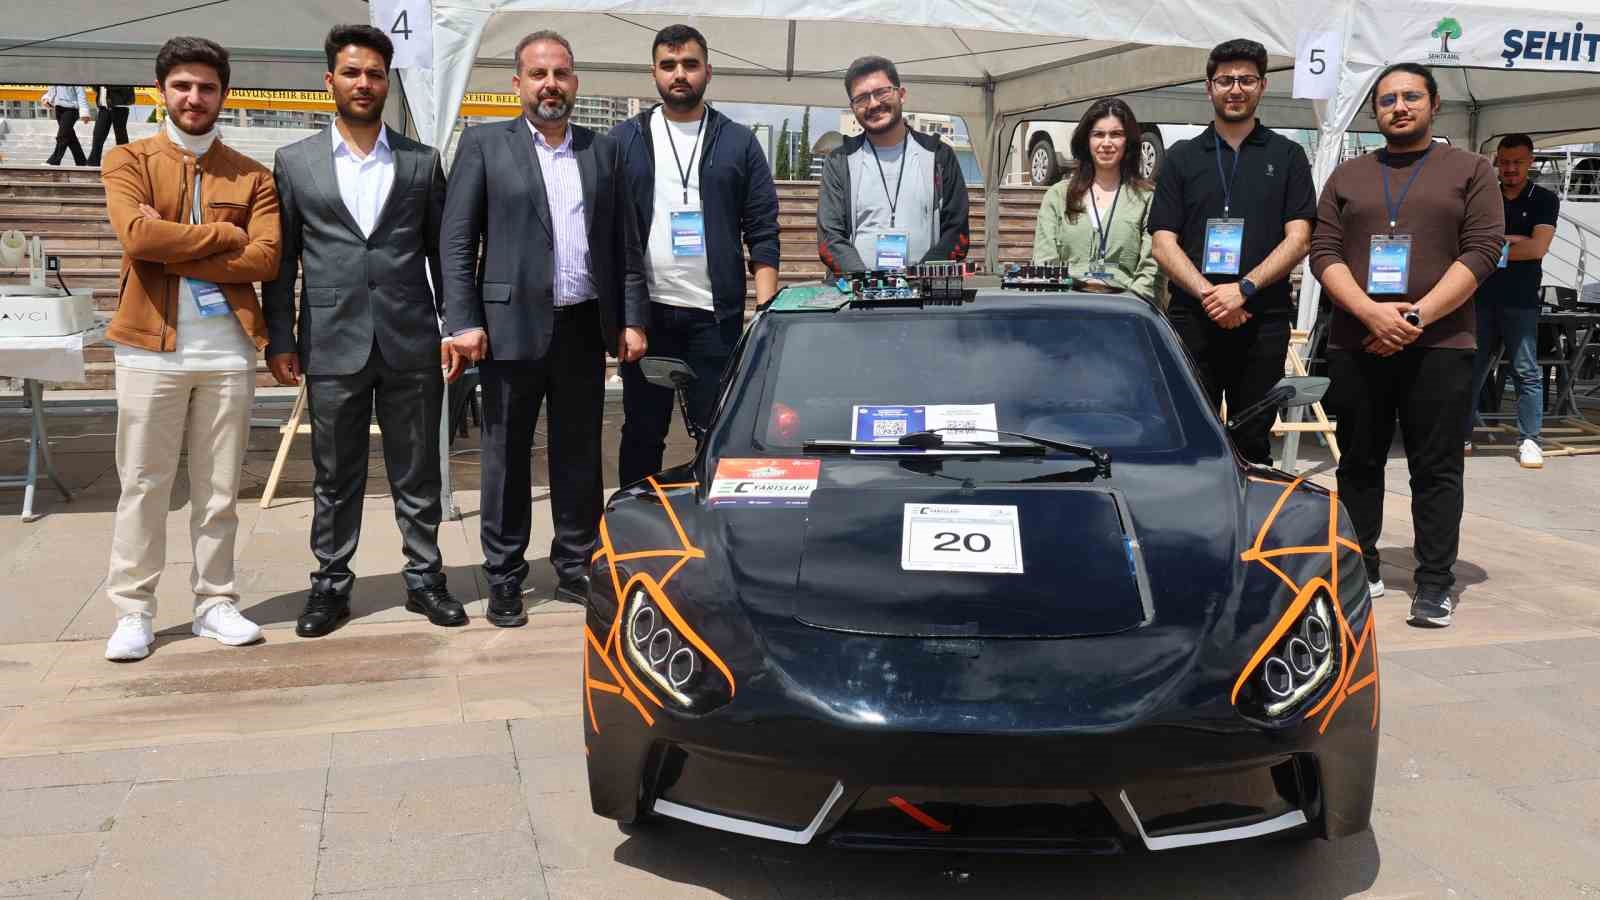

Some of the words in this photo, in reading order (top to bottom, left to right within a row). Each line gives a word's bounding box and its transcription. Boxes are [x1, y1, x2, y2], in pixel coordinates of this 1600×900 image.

[391, 9, 413, 40] 4
[1309, 48, 1326, 75] 5
[933, 531, 992, 553] 20
